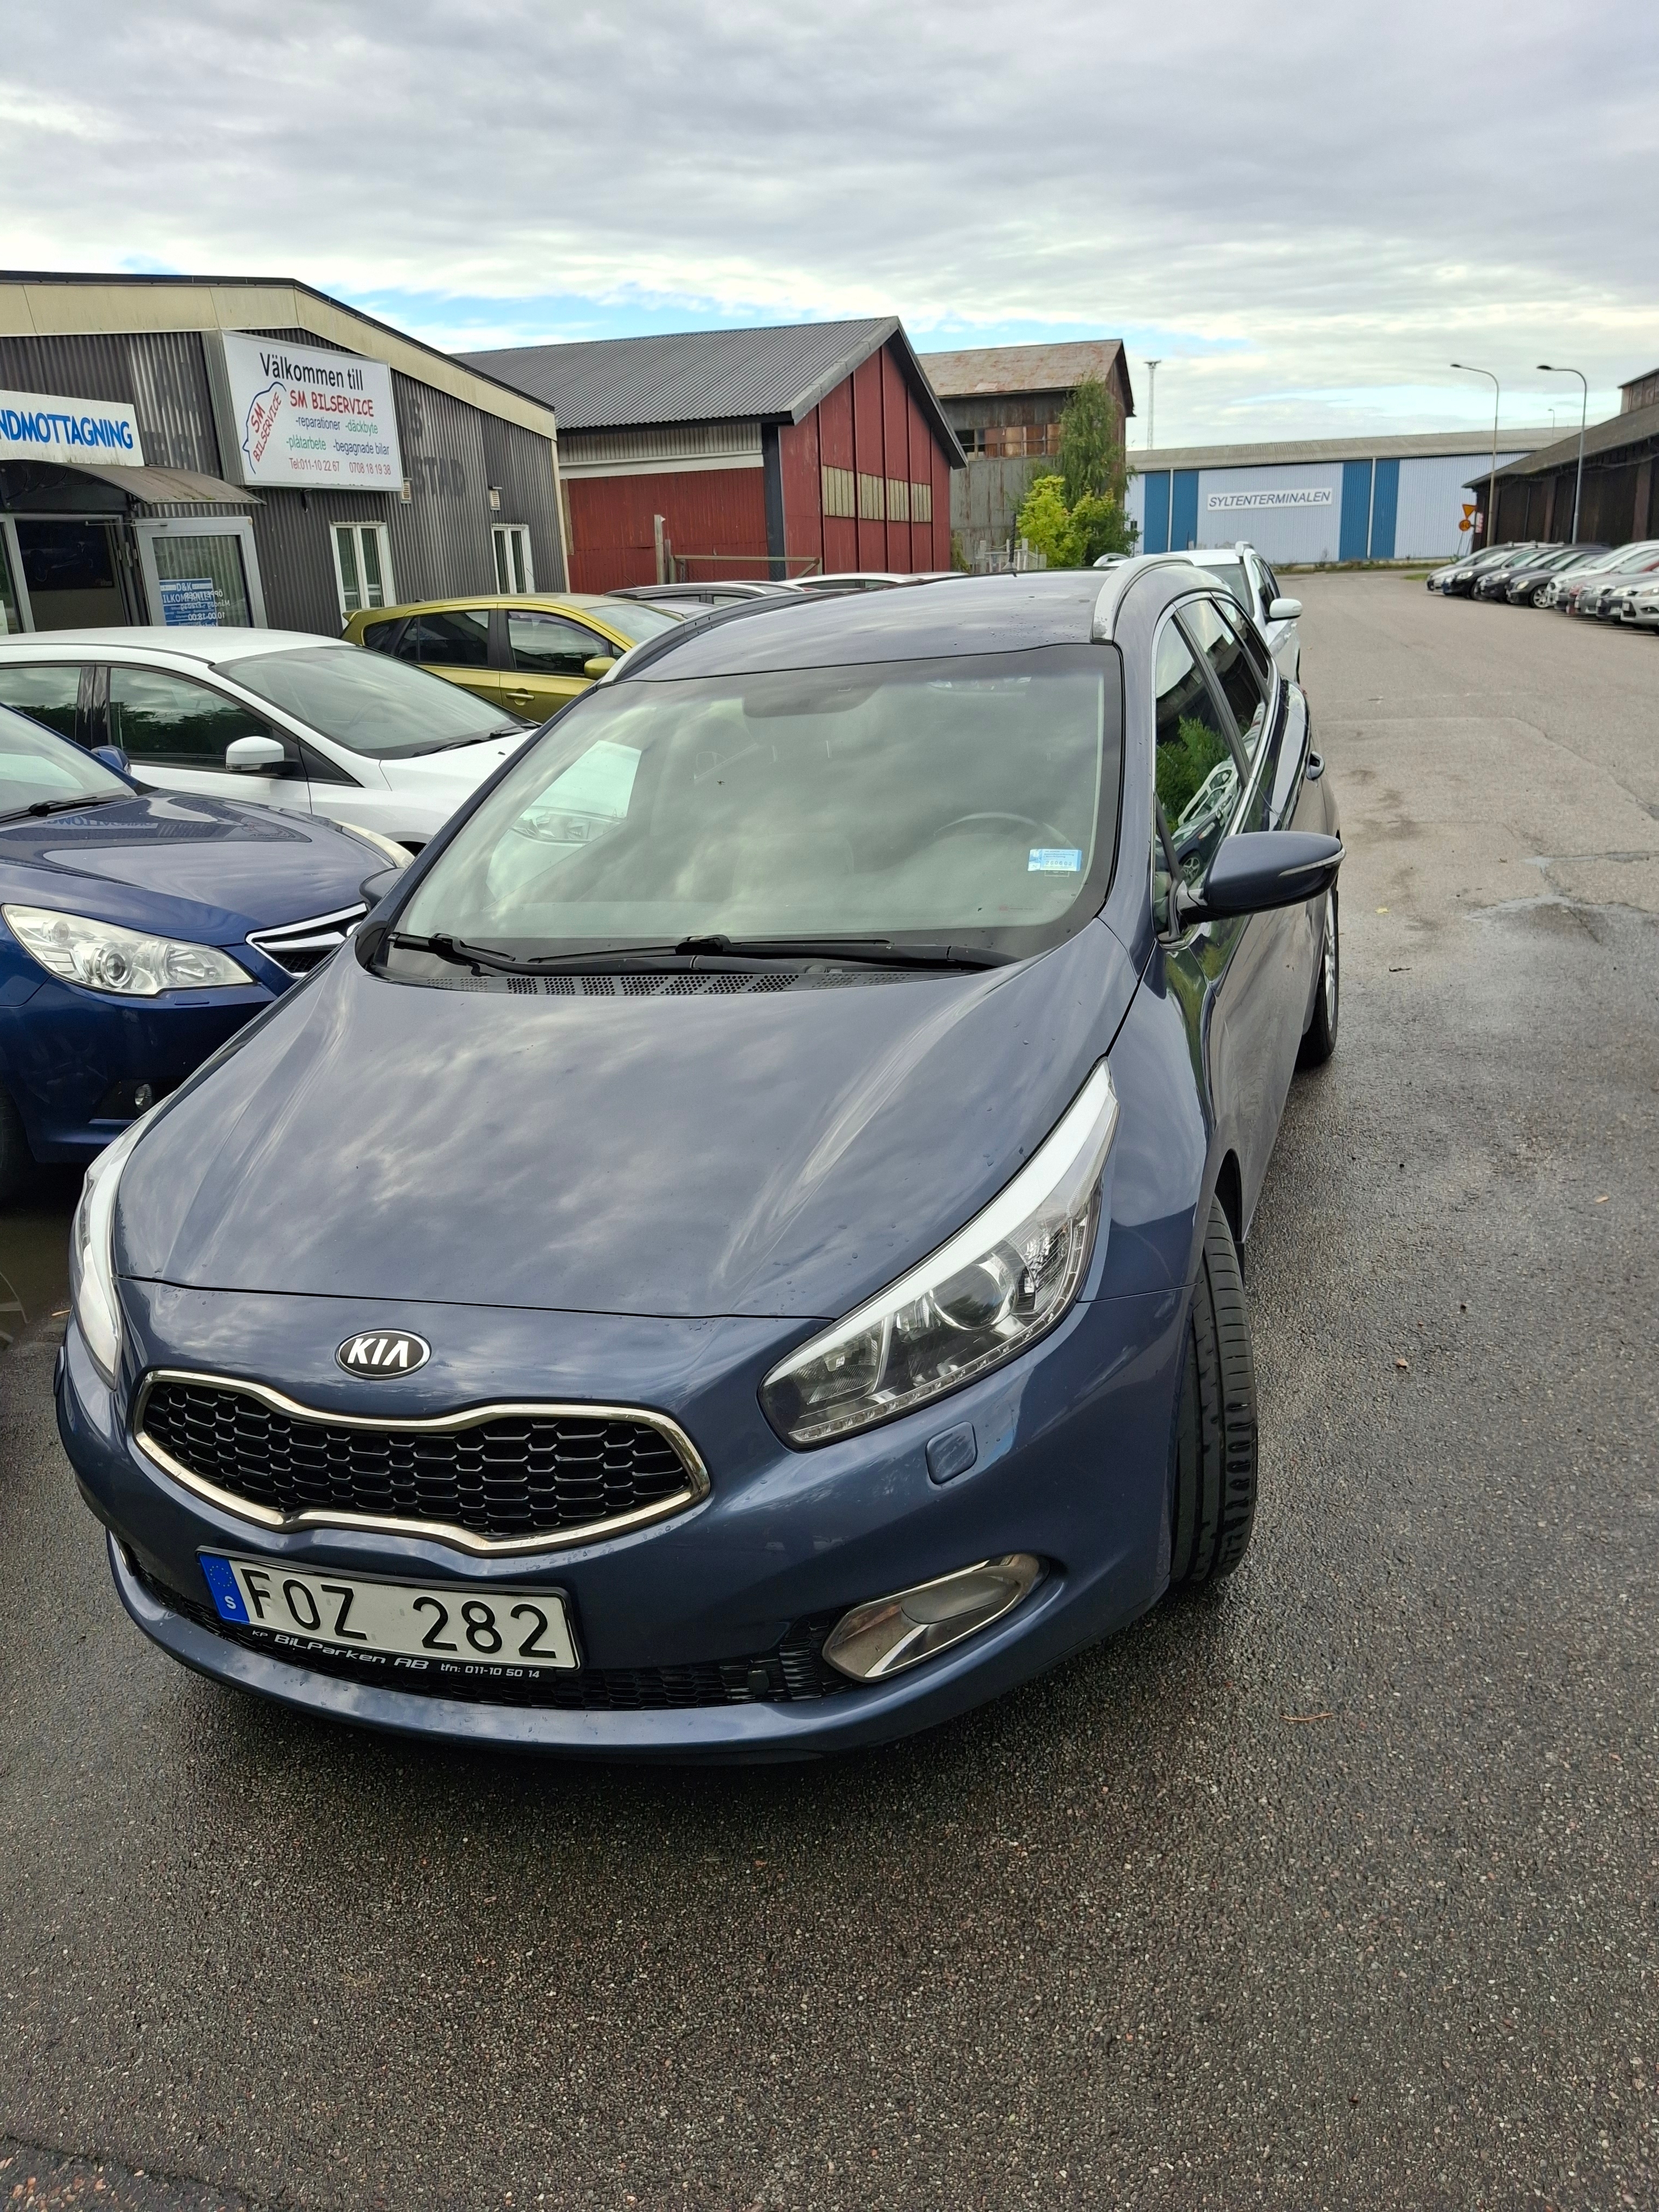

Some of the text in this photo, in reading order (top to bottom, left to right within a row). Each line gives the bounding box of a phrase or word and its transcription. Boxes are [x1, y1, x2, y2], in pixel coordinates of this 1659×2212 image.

[259, 352, 363, 390] Välkommen till
[290, 390, 374, 417] SM BILSERVICE
[250, 402, 266, 433] SM
[253, 391, 282, 462] BILSERVICE
[375, 441, 389, 455] bilar
[349, 462, 391, 475] 0708 18 19 38
[1209, 491, 1330, 507] SYLTENTERMINALEN
[176, 582, 193, 592] D&K
[347, 1338, 409, 1368] KIA
[224, 1595, 236, 1609] S
[240, 1567, 557, 1659] FOZ 282
[394, 1657, 429, 1669] AB
[440, 1663, 461, 1673] tfn:
[465, 1666, 502, 1675] 011-10
[506, 1668, 523, 1677] 50
[528, 1670, 540, 1679] 14
